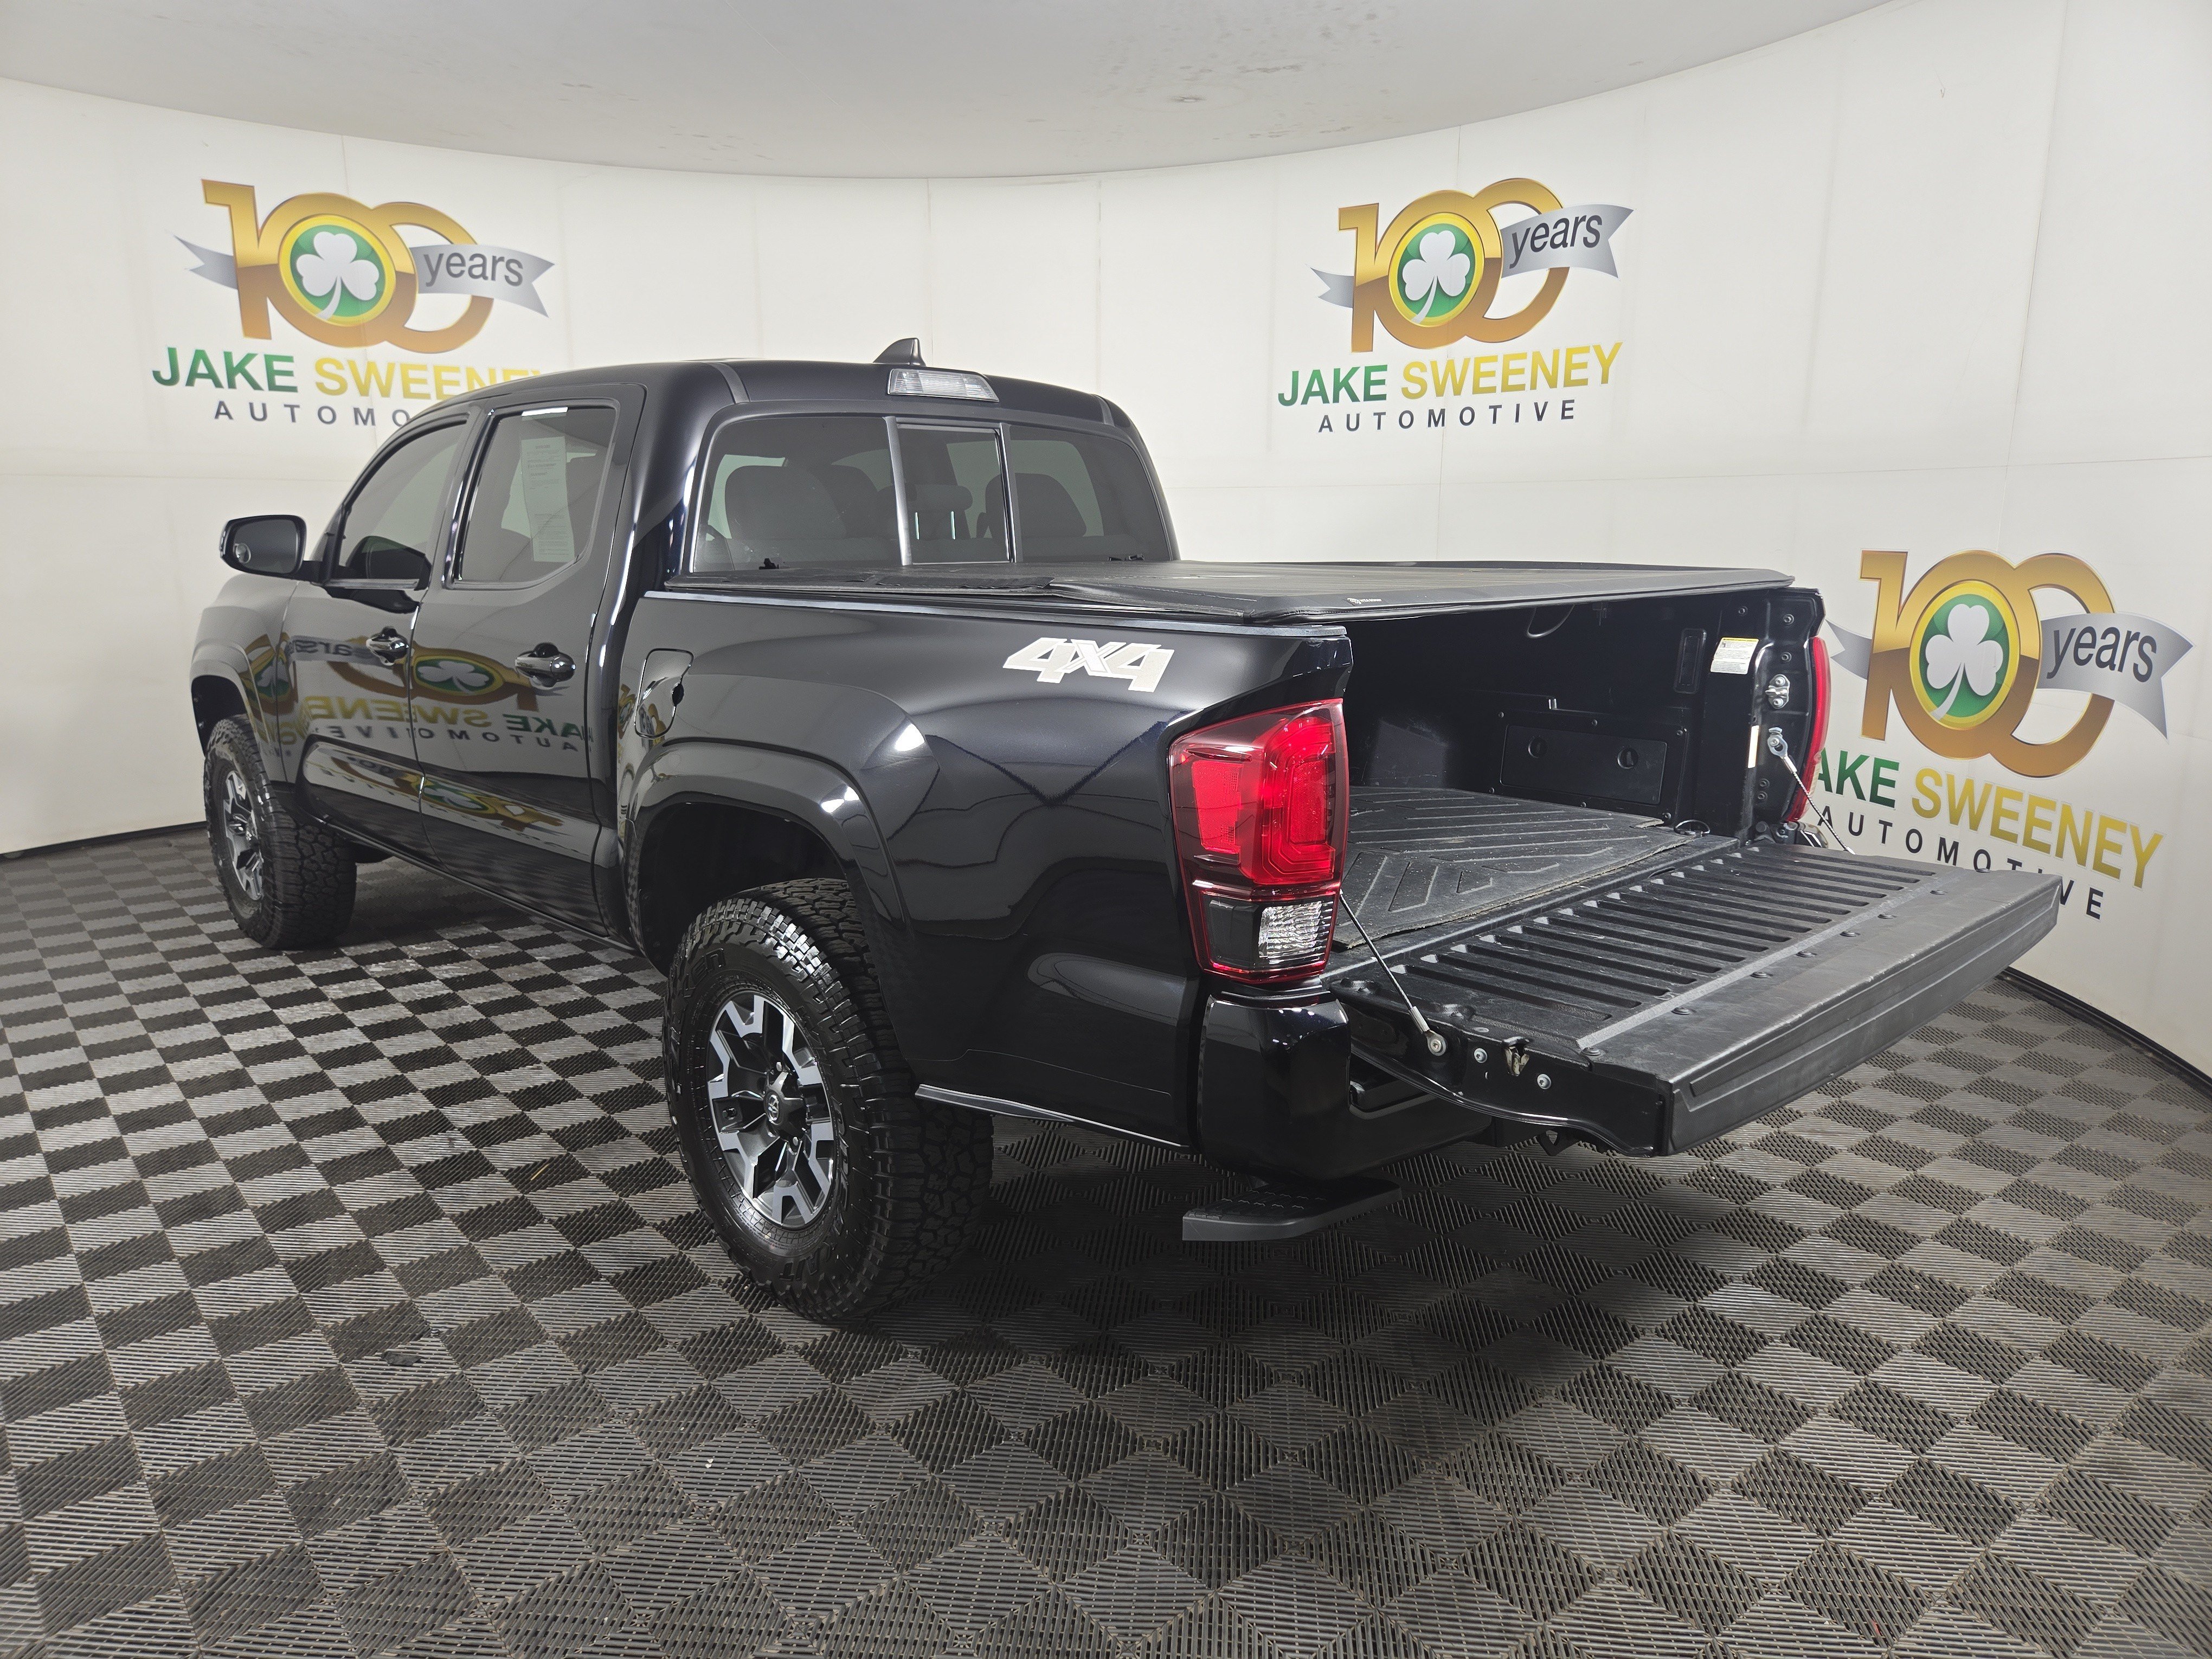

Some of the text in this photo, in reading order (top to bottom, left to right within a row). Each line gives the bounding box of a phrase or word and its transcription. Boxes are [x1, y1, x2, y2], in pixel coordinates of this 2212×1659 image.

[201, 178, 494, 353] 100
[423, 251, 524, 287] years
[1338, 177, 1571, 353] 100
[1509, 214, 1603, 269] years
[152, 347, 541, 401] JAKE SWEEN
[1278, 341, 1623, 406] JAKE SWEENEY
[215, 400, 409, 427] AUTOMO
[1319, 399, 1576, 433] AUTOMOTIVE
[1860, 550, 2115, 777] 100
[2047, 626, 2157, 683] years
[1818, 747, 2164, 890] AKE SWEENEY
[1818, 805, 2105, 921] AUTOMOTVE
